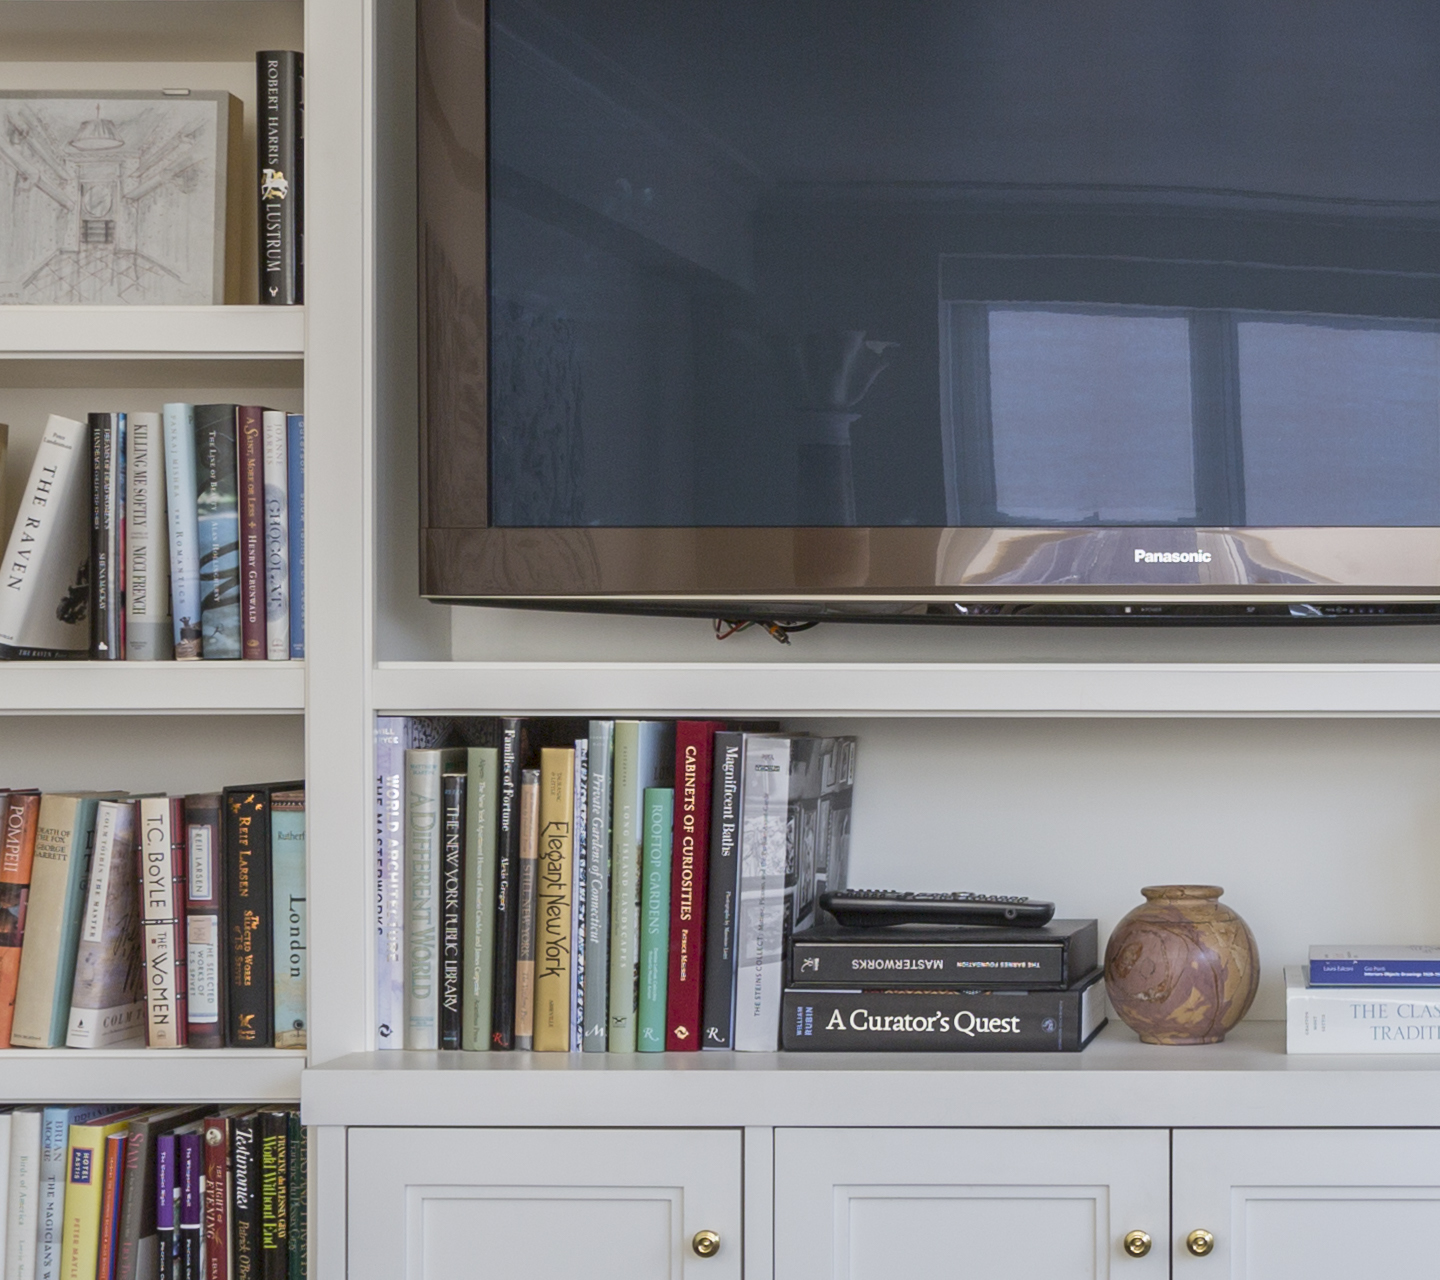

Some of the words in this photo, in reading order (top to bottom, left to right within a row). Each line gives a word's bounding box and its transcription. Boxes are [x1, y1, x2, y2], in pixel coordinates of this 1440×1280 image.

[268, 60, 279, 111] ROBERT
[268, 116, 279, 165] HARRIS
[267, 203, 281, 272] LUSTRUM
[133, 424, 147, 467] KILLING
[32, 465, 58, 506] THE
[133, 470, 148, 486] ME
[133, 488, 148, 527] SOFTLY
[7, 517, 41, 591] RAVEN
[1135, 549, 1211, 562] Panasonic
[684, 746, 696, 811] CABINETS
[3, 805, 23, 872] POMPEII
[651, 805, 663, 866] ROOFTOP
[683, 816, 694, 833] OF
[540, 822, 569, 890] Elegant
[681, 837, 694, 920] CURIOSITIES
[540, 895, 569, 934] New
[649, 872, 660, 934] GARDENS
[289, 894, 306, 979] London
[540, 936, 569, 978] York
[852, 959, 943, 969] MASTERWORKS
[826, 1009, 846, 1030] A
[849, 1009, 949, 1031] Curator's
[954, 1011, 1020, 1036] Quest
[81, 1152, 89, 1180] HOTEL
[236, 1128, 253, 1209] Testimonies
